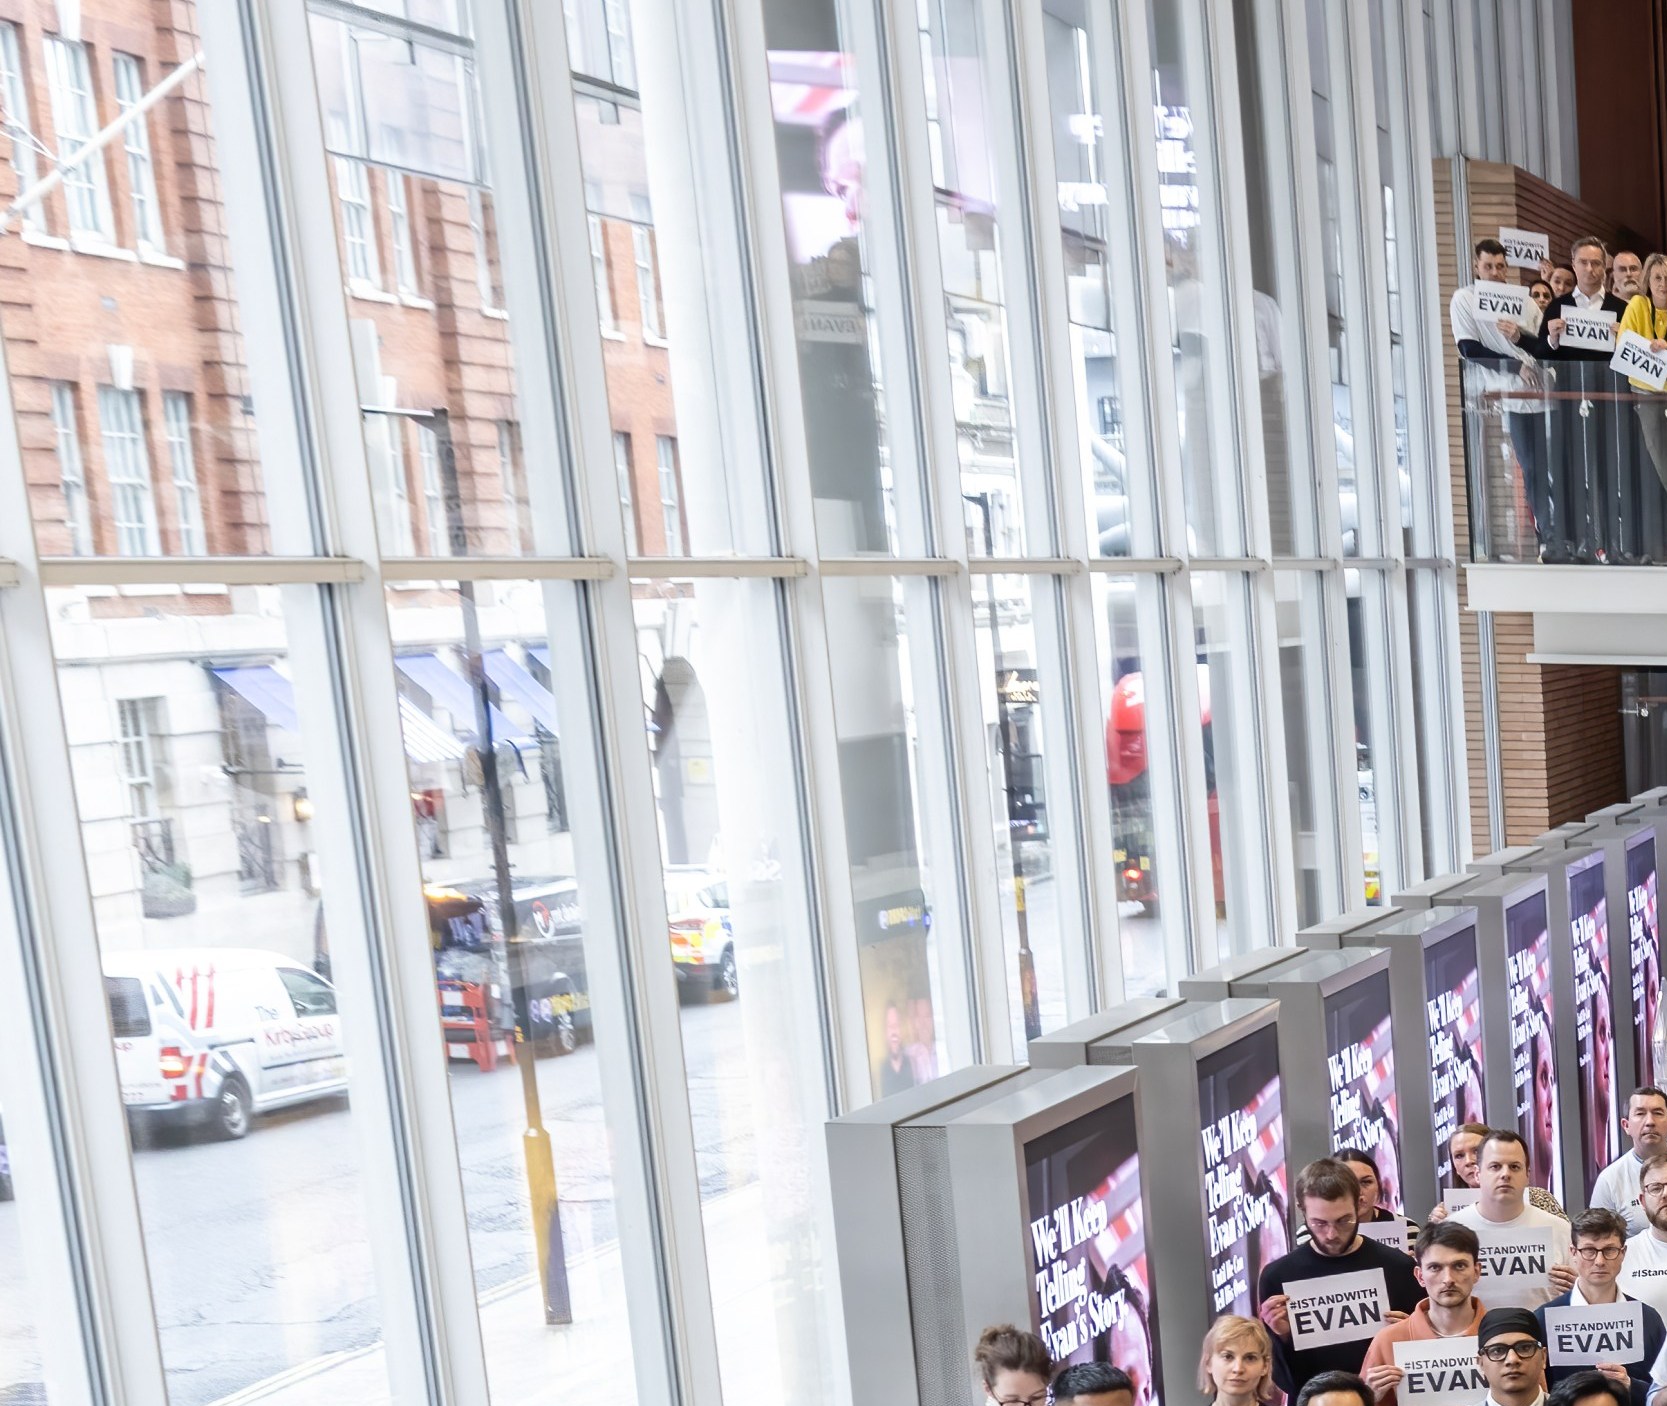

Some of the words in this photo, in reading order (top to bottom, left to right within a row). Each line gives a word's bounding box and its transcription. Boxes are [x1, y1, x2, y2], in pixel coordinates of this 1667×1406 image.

[1351, 1043, 1373, 1080] Keep
[1331, 1088, 1362, 1132] Telling
[1202, 1116, 1231, 1168] We'll
[1230, 1110, 1257, 1150] Keep
[1205, 1162, 1244, 1213] Telling
[1031, 1202, 1073, 1267] We'll
[1070, 1197, 1107, 1246] Keep
[1208, 1204, 1244, 1258] Evan's
[1244, 1192, 1273, 1233] Story.
[1036, 1257, 1088, 1319] Telling
[1286, 1288, 1378, 1310] #ISTANDWITH
[1088, 1288, 1130, 1339] Story.
[1296, 1302, 1381, 1335] EVAN
[1554, 1319, 1634, 1332] #ISTANDWITH
[1557, 1330, 1633, 1353] EVAN
